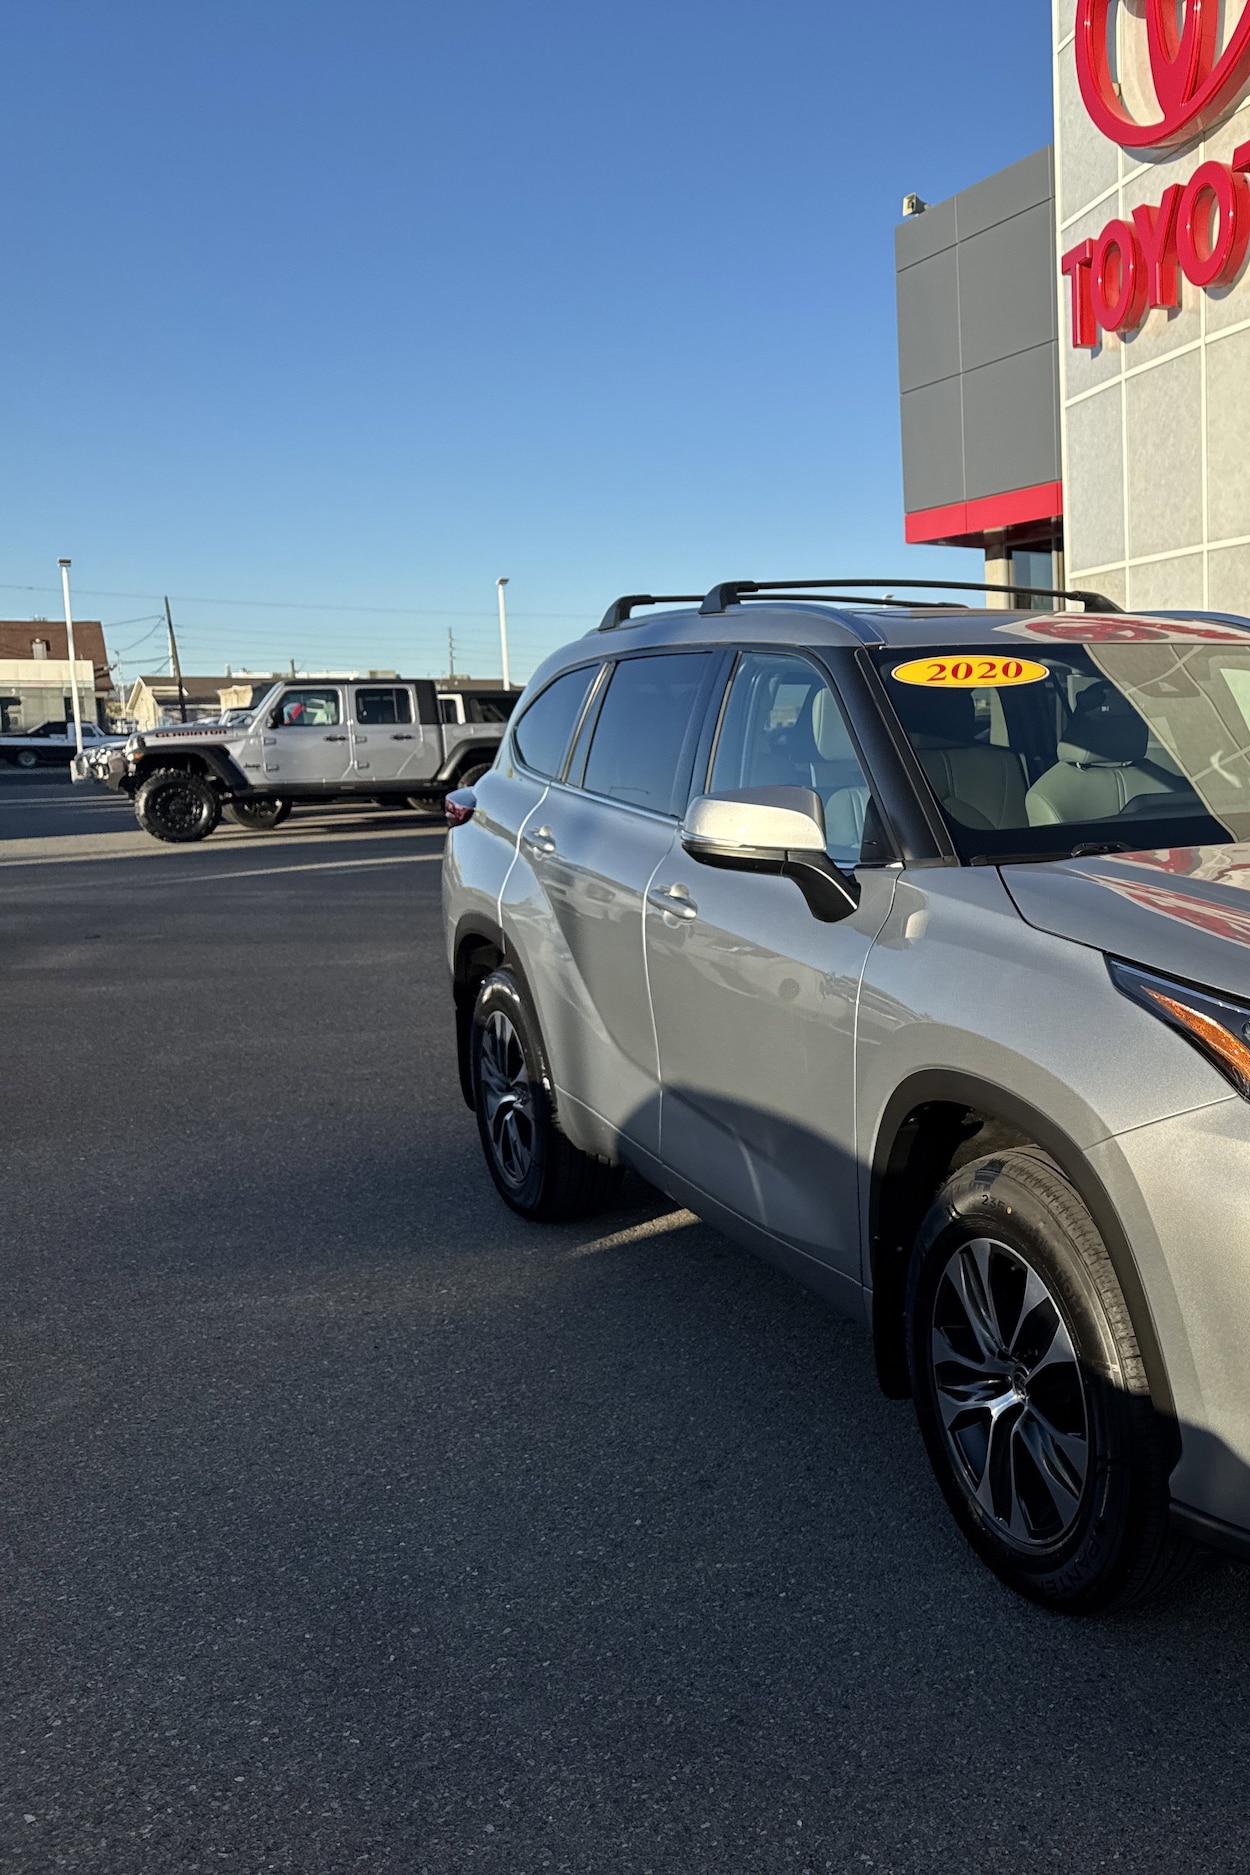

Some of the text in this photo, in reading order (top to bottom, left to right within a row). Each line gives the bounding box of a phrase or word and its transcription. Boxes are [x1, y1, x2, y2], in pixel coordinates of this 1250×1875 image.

[926, 661, 1023, 682] 2020
[155, 730, 228, 739] GLADIATOR
[244, 762, 262, 770] Jeep
